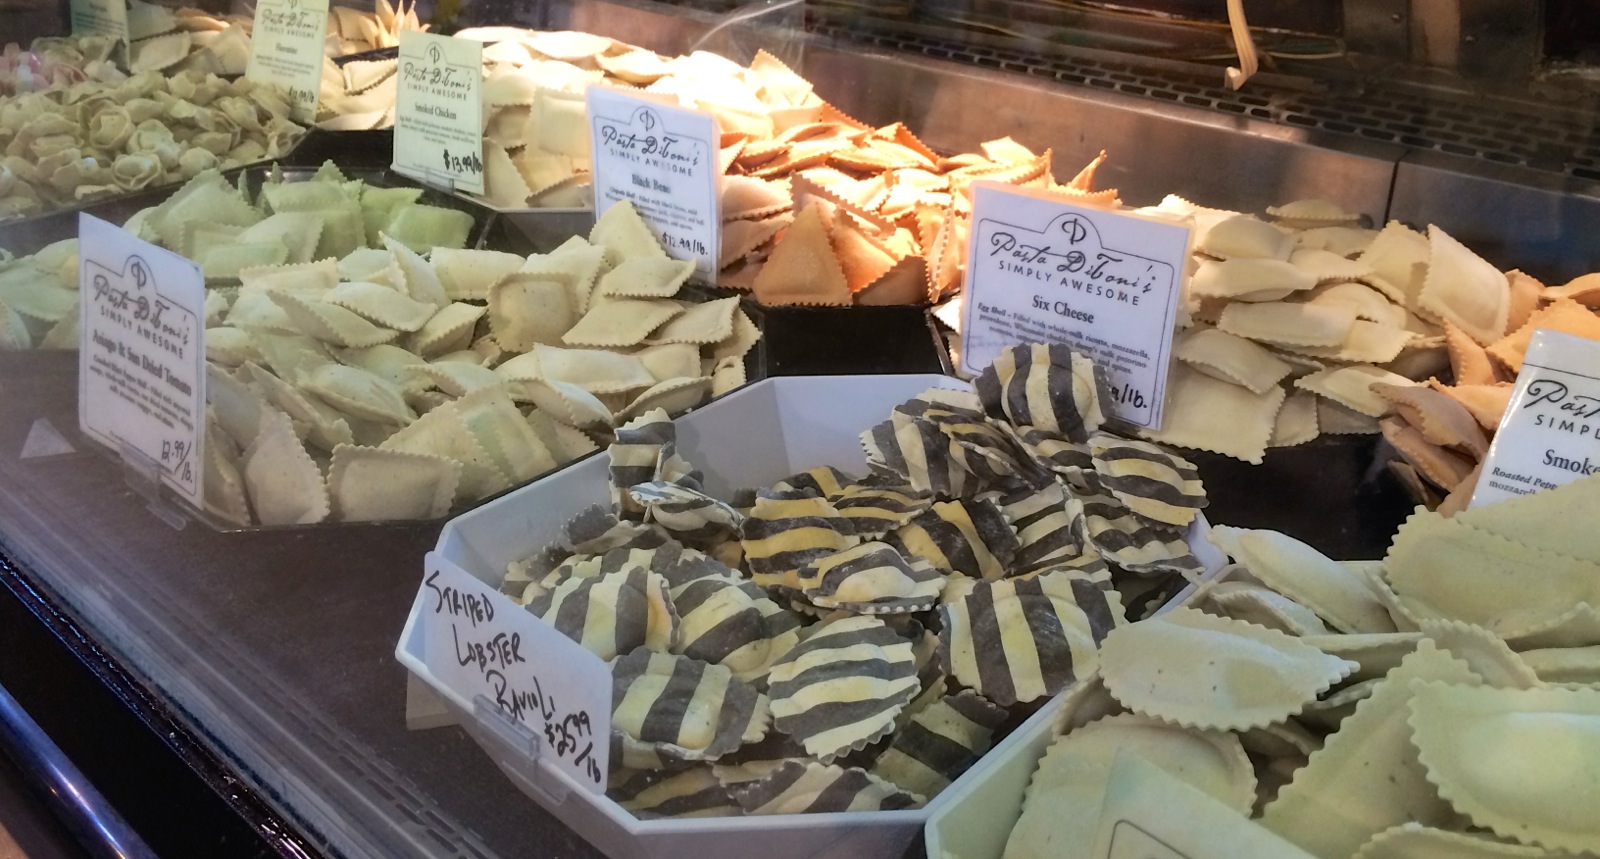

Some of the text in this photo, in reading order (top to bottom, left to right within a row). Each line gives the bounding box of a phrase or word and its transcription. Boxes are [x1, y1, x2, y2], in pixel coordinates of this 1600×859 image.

[407, 82, 467, 101] SIMPLY AWESOME
[435, 106, 457, 121] Chicken
[601, 125, 636, 149] Pasta
[609, 147, 640, 163] SIMPLY
[632, 173, 651, 189] Black
[990, 231, 1051, 264] Pasta
[93, 273, 129, 310] Pasta
[998, 260, 1140, 307] SIMPLY AWESOME
[1032, 294, 1095, 324] Six Cheese
[100, 305, 183, 360] SIMPLY AWESOME
[978, 302, 990, 314] Egg
[991, 306, 1007, 317] Shell
[1032, 318, 1046, 329] with
[1048, 324, 1083, 340] whole-milk
[1111, 342, 1150, 360] mozzarella,
[127, 346, 140, 366] Sun
[142, 354, 163, 379] Dried
[1108, 383, 1147, 408] 9/lb.
[1492, 466, 1533, 485] Roasted
[425, 570, 494, 628] STRIPED
[452, 623, 526, 673] LOBSTER
[485, 669, 556, 724] RAVIOLI
